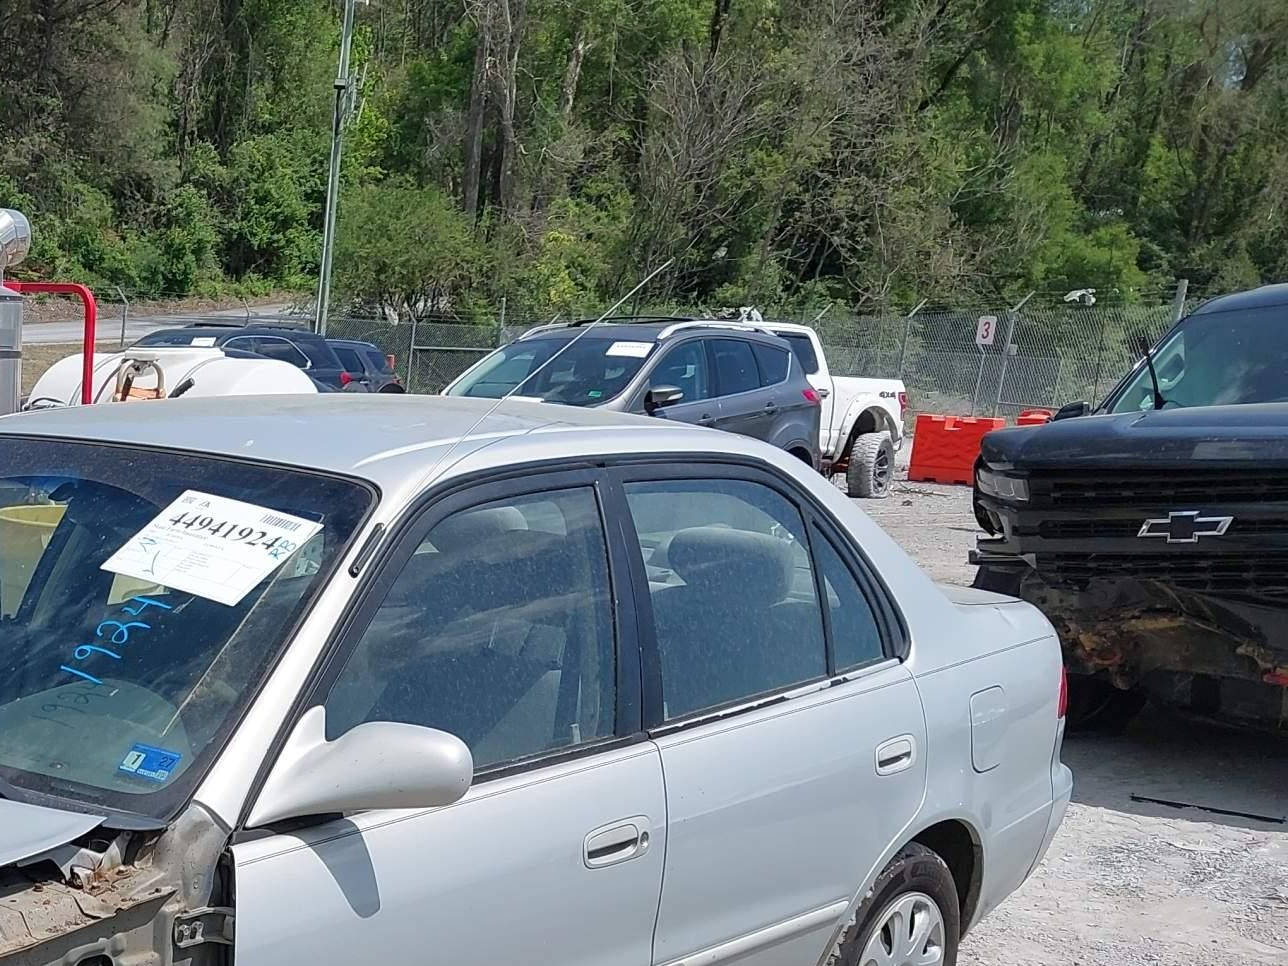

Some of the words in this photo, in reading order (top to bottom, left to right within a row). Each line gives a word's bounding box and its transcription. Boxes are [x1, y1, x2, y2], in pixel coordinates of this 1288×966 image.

[982, 321, 991, 339] 3
[169, 511, 282, 550] 44941924
[60, 596, 172, 684] 1924
[131, 754, 142, 765] 1
[159, 756, 175, 768] 27
